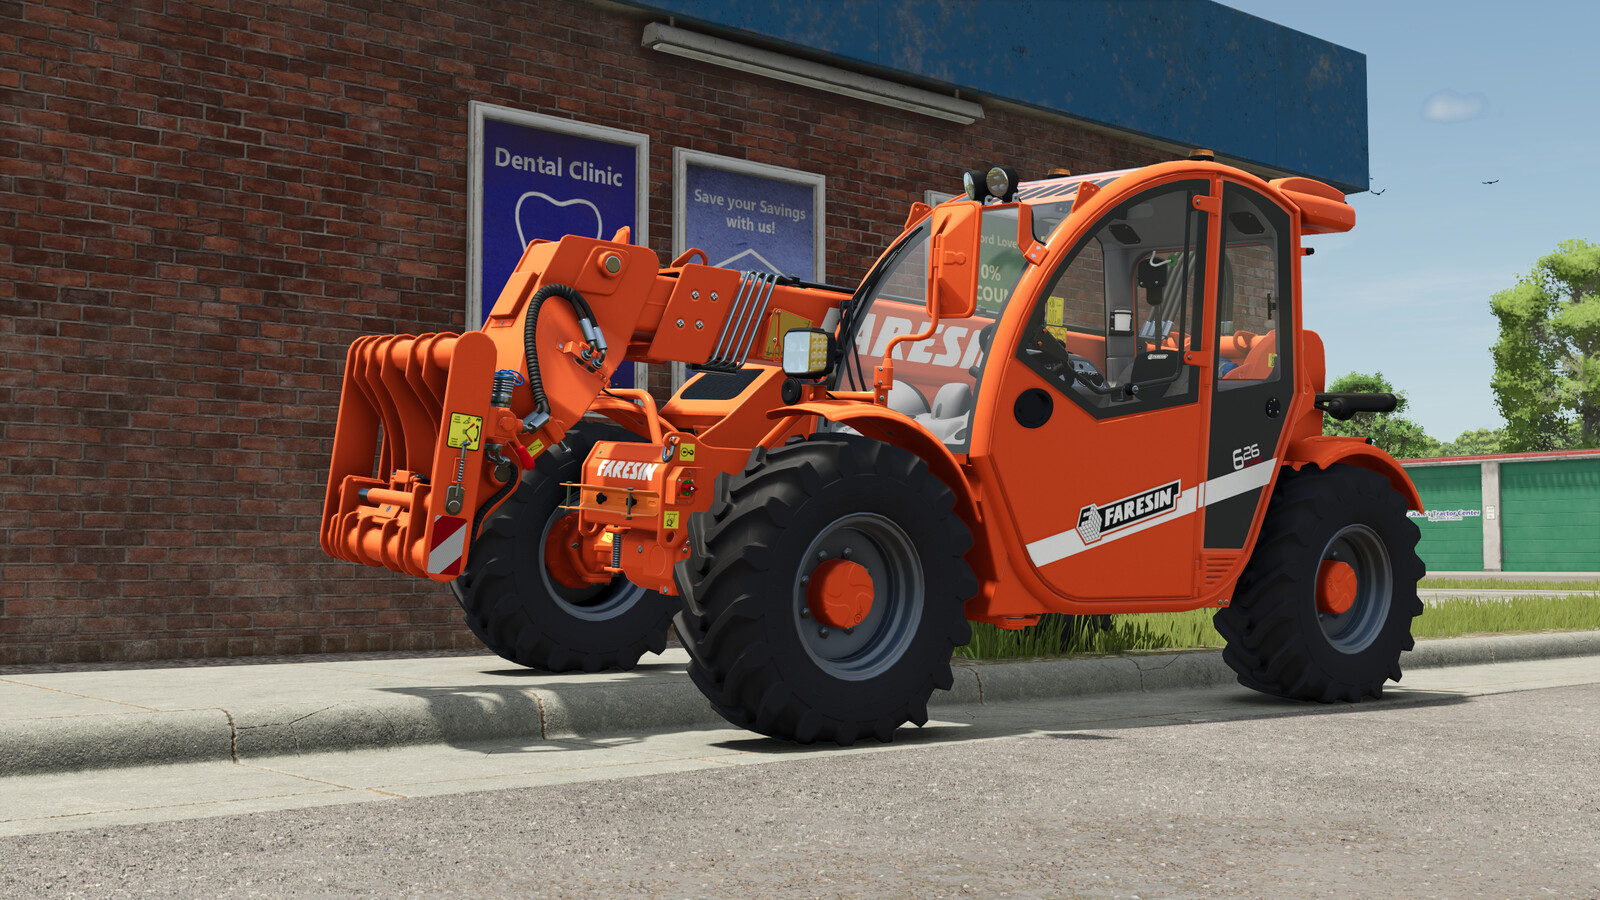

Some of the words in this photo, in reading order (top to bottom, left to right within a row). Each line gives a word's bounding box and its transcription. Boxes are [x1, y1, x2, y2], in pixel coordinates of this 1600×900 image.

[495, 147, 562, 177] Dental
[569, 161, 623, 187] Clinic
[694, 189, 724, 206] Save
[727, 197, 757, 211] your
[760, 200, 806, 222] Savings
[726, 216, 754, 232] with
[757, 221, 776, 235] us!
[997, 235, 1018, 249] Love
[980, 263, 1001, 281] 0%
[820, 307, 984, 370] ARESI
[596, 459, 660, 482] FARESIN
[1232, 443, 1260, 471] 626
[1104, 487, 1173, 528] FARESIN
